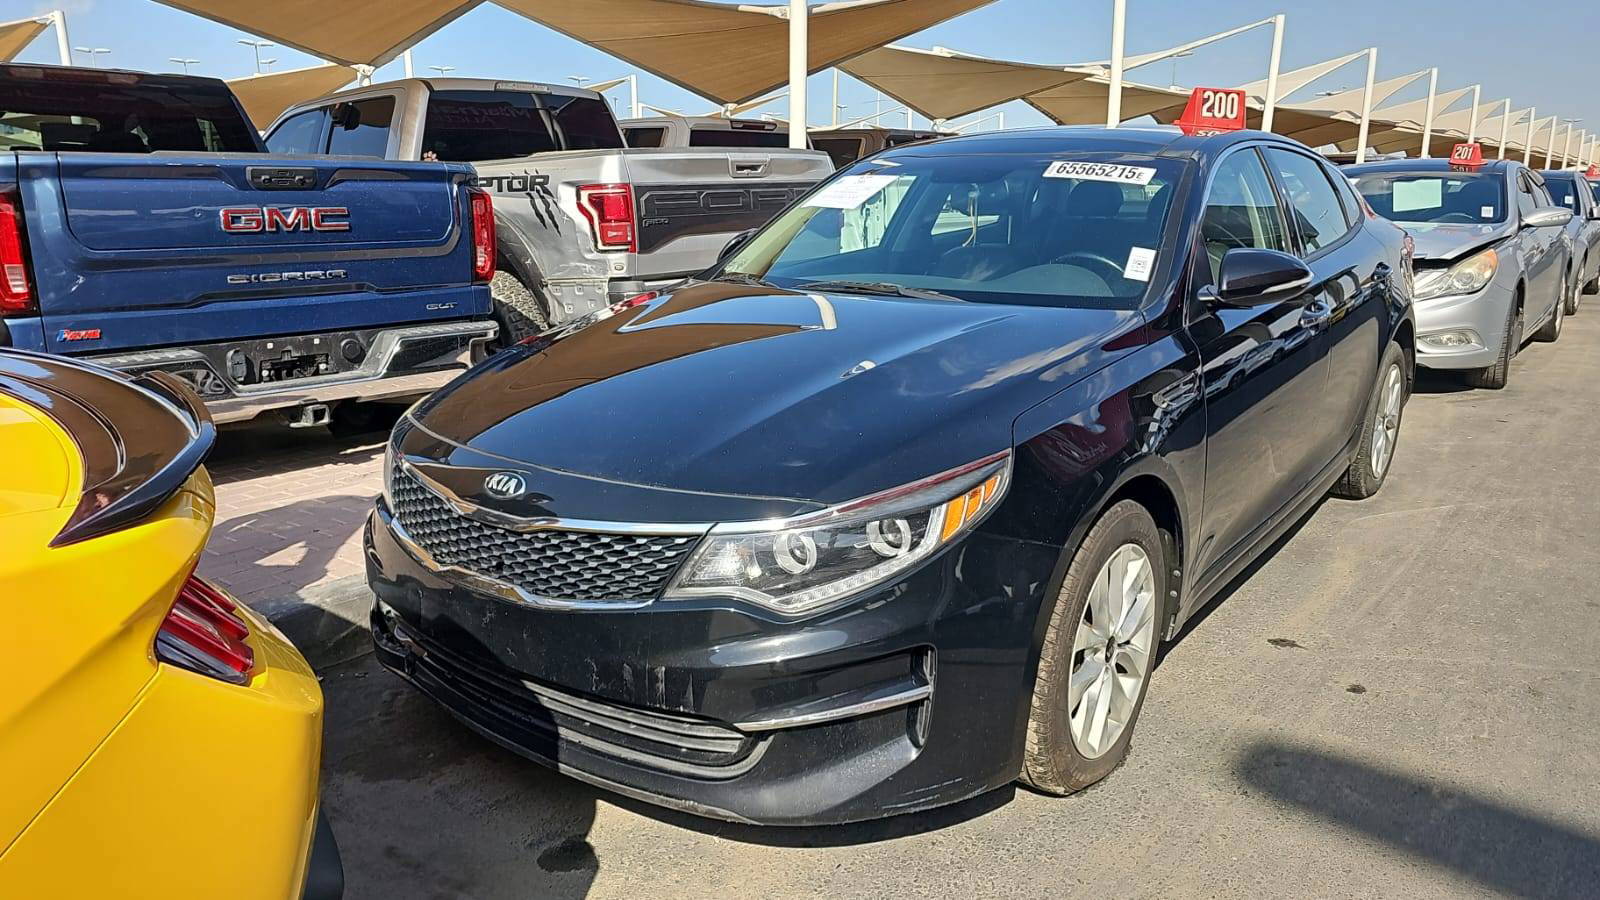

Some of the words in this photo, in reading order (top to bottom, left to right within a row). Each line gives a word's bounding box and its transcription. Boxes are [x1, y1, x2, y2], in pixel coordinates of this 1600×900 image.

[1201, 90, 1239, 119] 200
[1454, 146, 1474, 160] 201
[478, 174, 551, 193] PTOR
[640, 188, 808, 217] FOR
[219, 206, 350, 232] GMC
[227, 269, 348, 284] SIERRA
[487, 473, 518, 494] KIA
